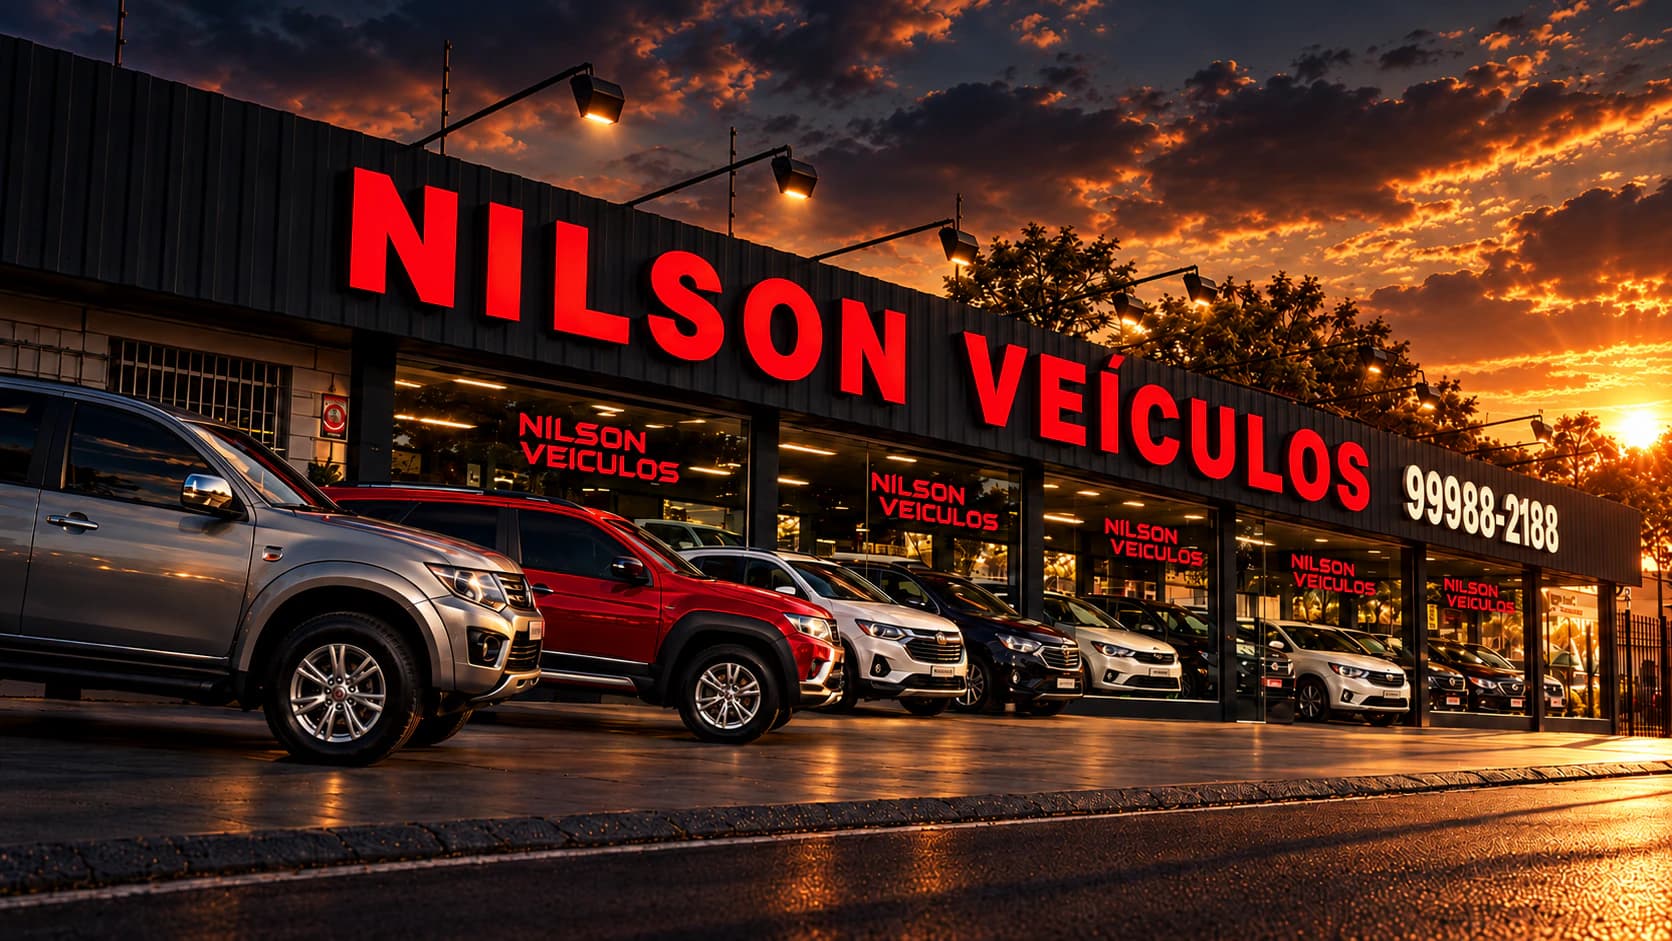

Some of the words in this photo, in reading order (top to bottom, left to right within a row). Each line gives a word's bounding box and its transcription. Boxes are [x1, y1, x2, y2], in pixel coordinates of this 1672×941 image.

[349, 166, 907, 405] NILSON
[963, 331, 1371, 512] VEÍCULOS
[519, 412, 647, 454] NILSON
[520, 441, 680, 485] VEICULOS
[871, 471, 965, 506] NILSON
[879, 495, 999, 532] VEICULOS
[1405, 464, 1560, 554] 99988-2188
[1104, 517, 1178, 545] NILSON
[1110, 538, 1204, 568] VEICULOS
[1291, 552, 1355, 578] NILSON
[1293, 571, 1377, 597] VEICULOS
[1443, 577, 1499, 599] NILSON
[1446, 593, 1517, 616] VEICULOS
